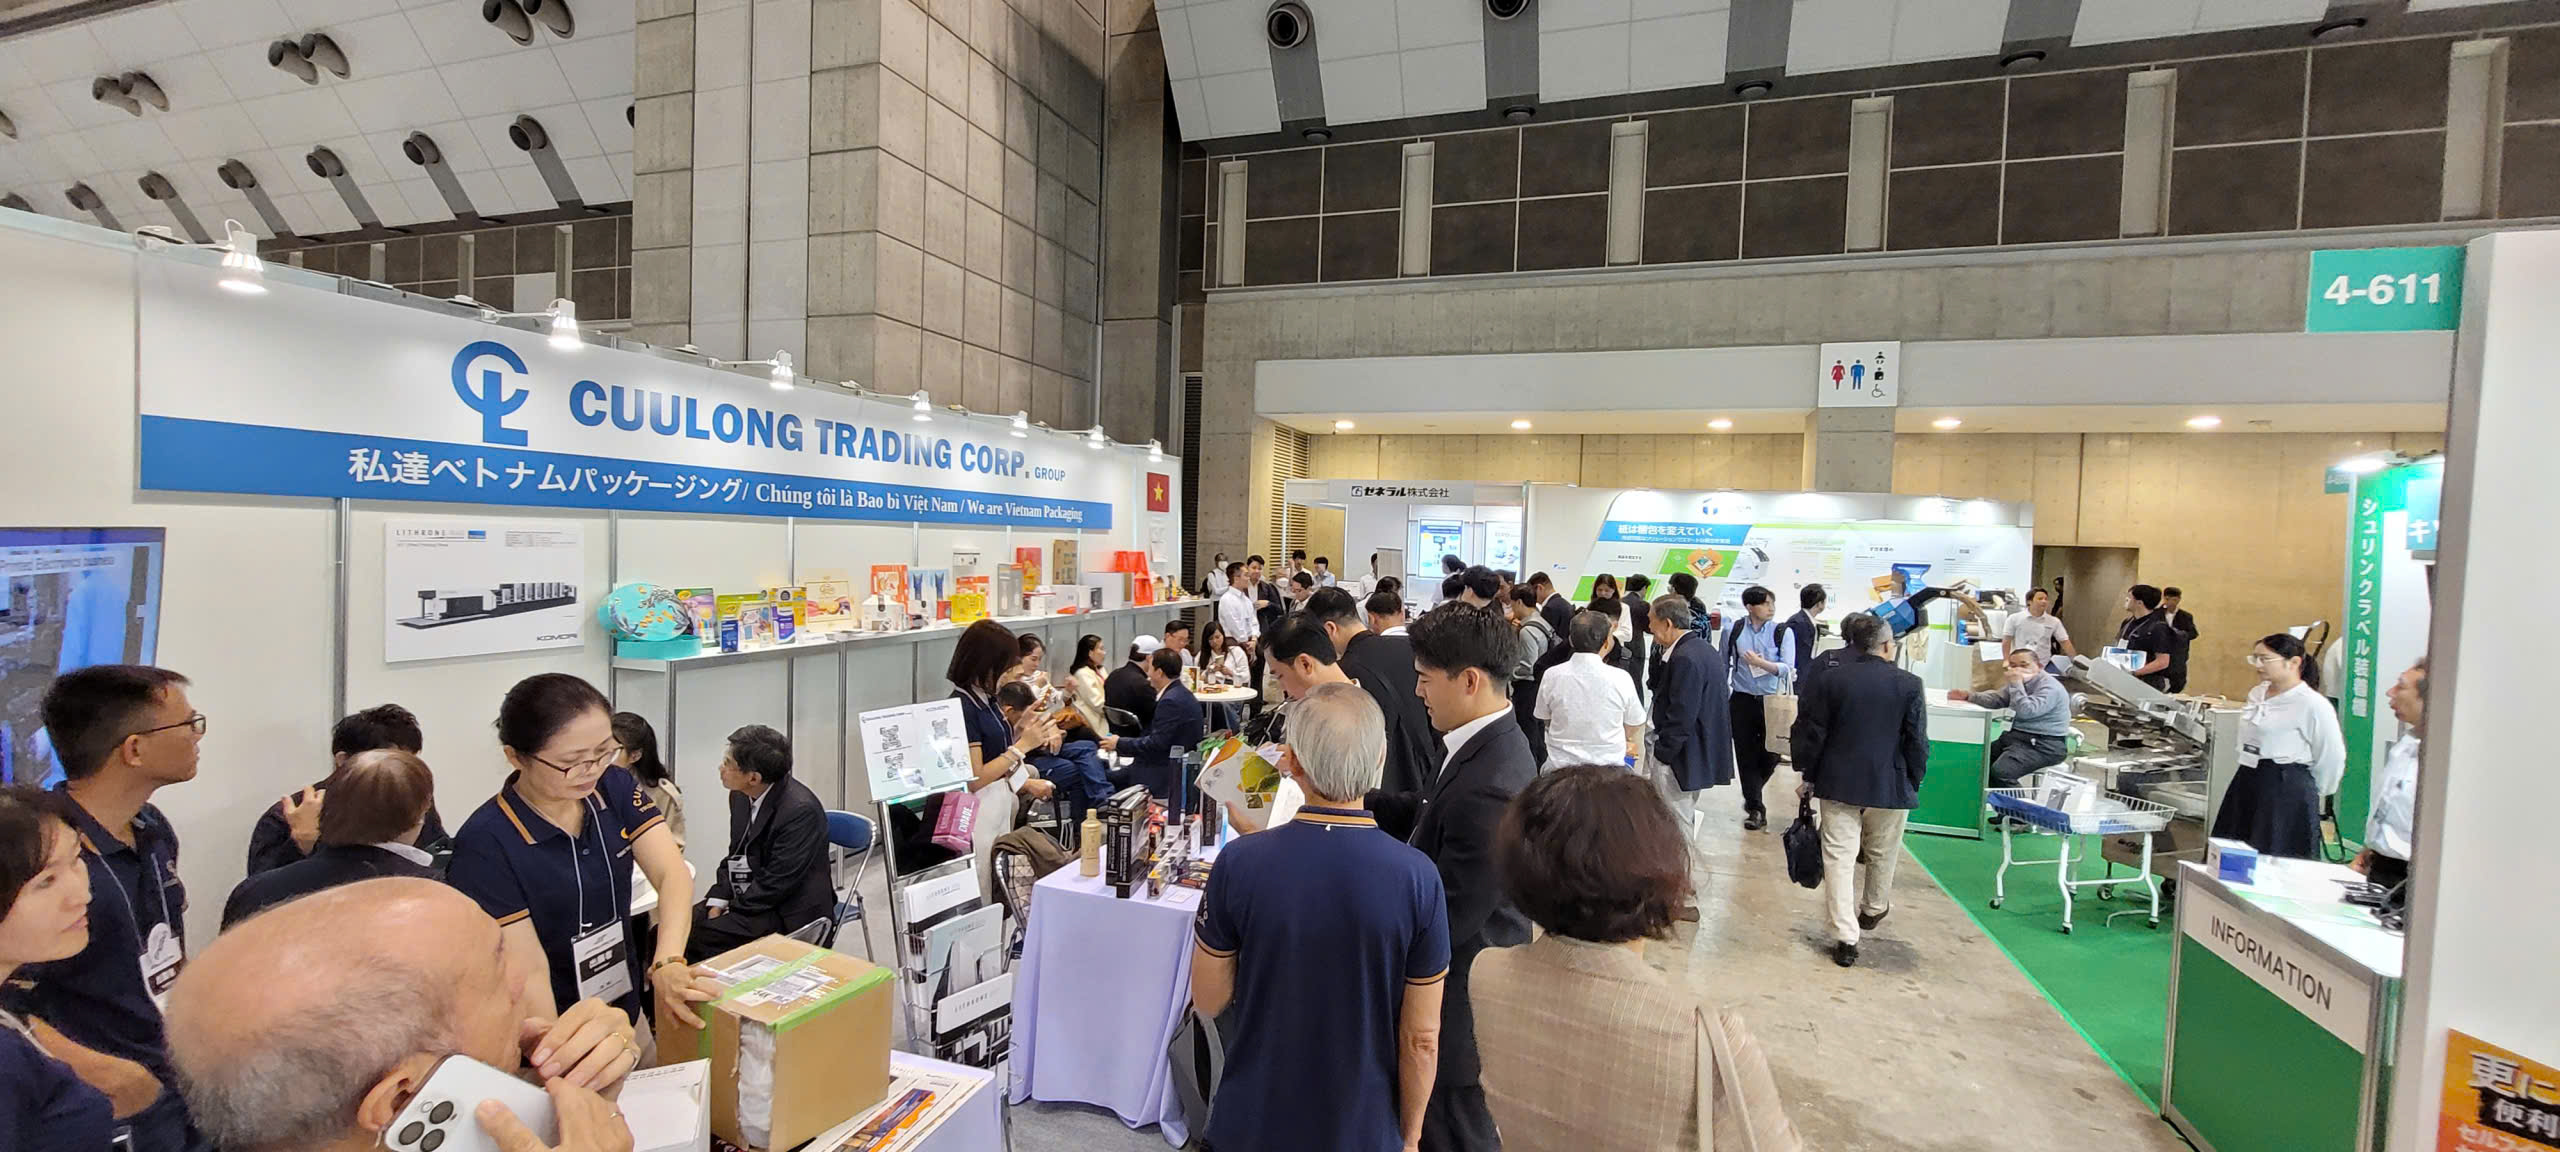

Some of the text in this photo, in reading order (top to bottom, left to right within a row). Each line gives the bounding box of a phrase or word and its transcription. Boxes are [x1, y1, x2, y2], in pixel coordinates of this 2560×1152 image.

[2323, 273, 2441, 305] 4-611
[569, 379, 1067, 482] CUULONG TRADING CORP. GROUP
[755, 482, 813, 509] Chúng
[816, 489, 837, 507] tôi
[840, 488, 854, 507] là
[857, 492, 884, 510] Bao
[885, 493, 901, 510] bì
[902, 493, 929, 515] Việt
[931, 497, 959, 513] Nam
[967, 500, 985, 515] We
[986, 504, 1003, 516] are
[1004, 503, 1042, 519] Vietnam
[1043, 505, 1084, 523] Packaging
[1363, 486, 1450, 498] ゼネラル株式会社
[2407, 518, 2440, 544] キ
[2210, 915, 2333, 1012] INFORMATION
[2467, 1050, 2558, 1105] 更に
[2493, 1098, 2559, 1140] 便利
